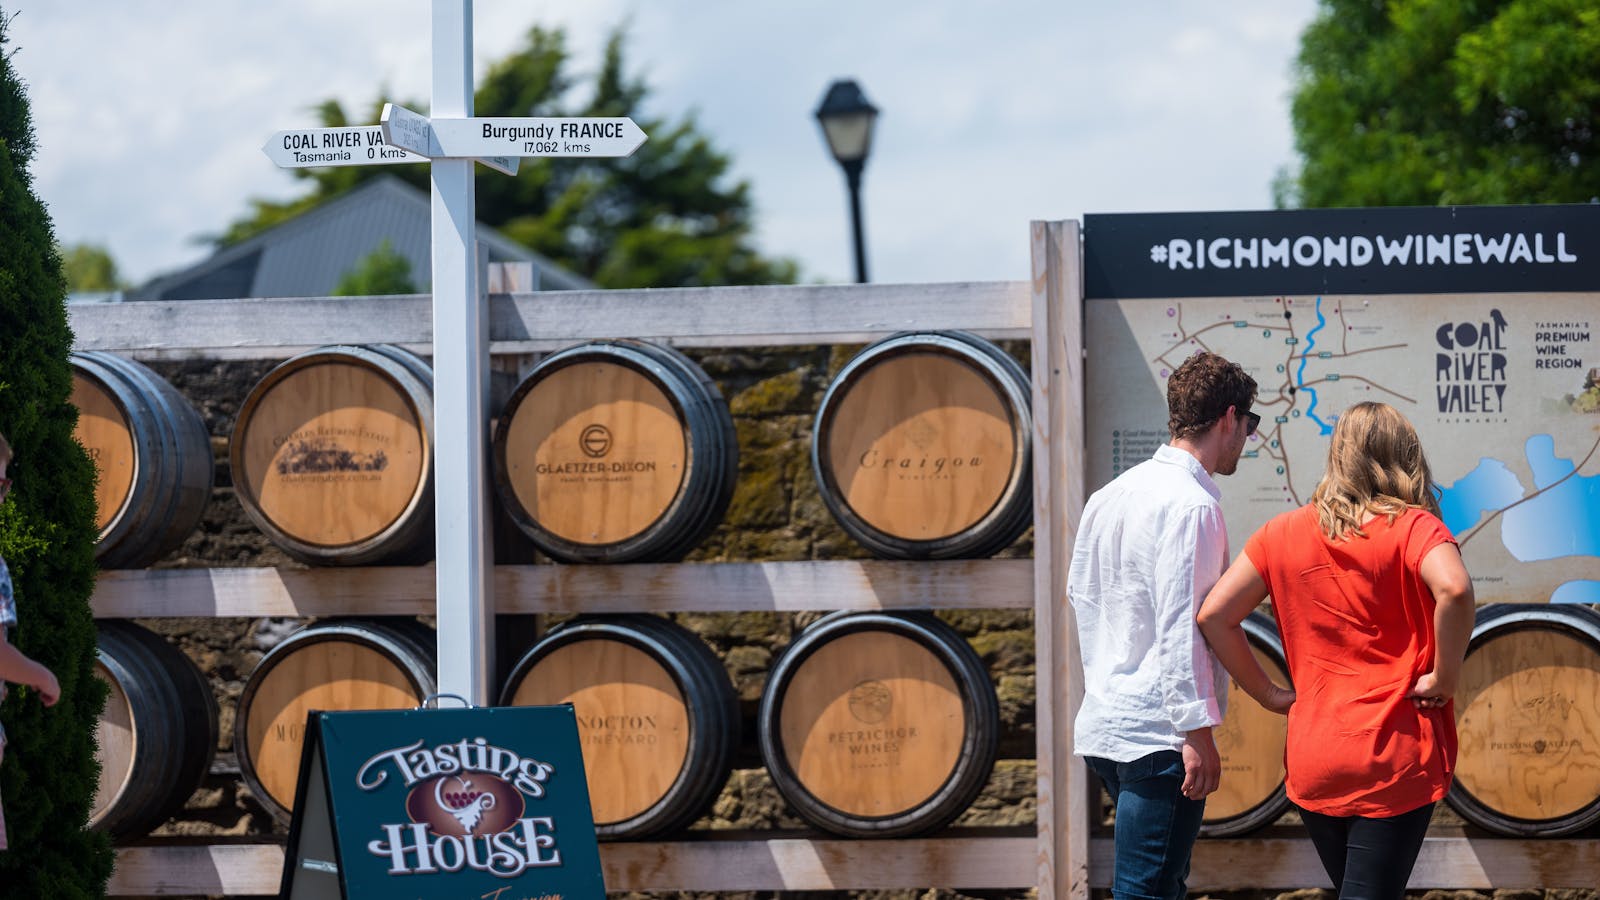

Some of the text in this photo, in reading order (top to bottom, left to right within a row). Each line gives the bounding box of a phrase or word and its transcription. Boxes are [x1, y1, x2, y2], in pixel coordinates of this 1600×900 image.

[482, 123, 624, 142] Burgundy FRANCE
[283, 134, 318, 150] COAL
[323, 132, 361, 148] RIVER
[524, 141, 591, 153] 17,062 kms
[293, 147, 407, 162] Tasmania 0 kms
[1150, 232, 1577, 270] #RICHMONDWINEWALL
[1436, 319, 1508, 350] COAL
[1535, 332, 1590, 342] PREMIUM
[1535, 345, 1567, 355] WINE
[1535, 358, 1582, 369] REGION
[1436, 384, 1508, 413] VALLEY
[535, 461, 657, 474] GLAETZER-DIXON
[860, 449, 982, 473] Craigow
[578, 715, 657, 729] NOCTON
[828, 727, 918, 743] PETRICHOR
[849, 742, 900, 755] WINES
[356, 737, 555, 799] Tasting
[367, 816, 562, 879] HOUSE
